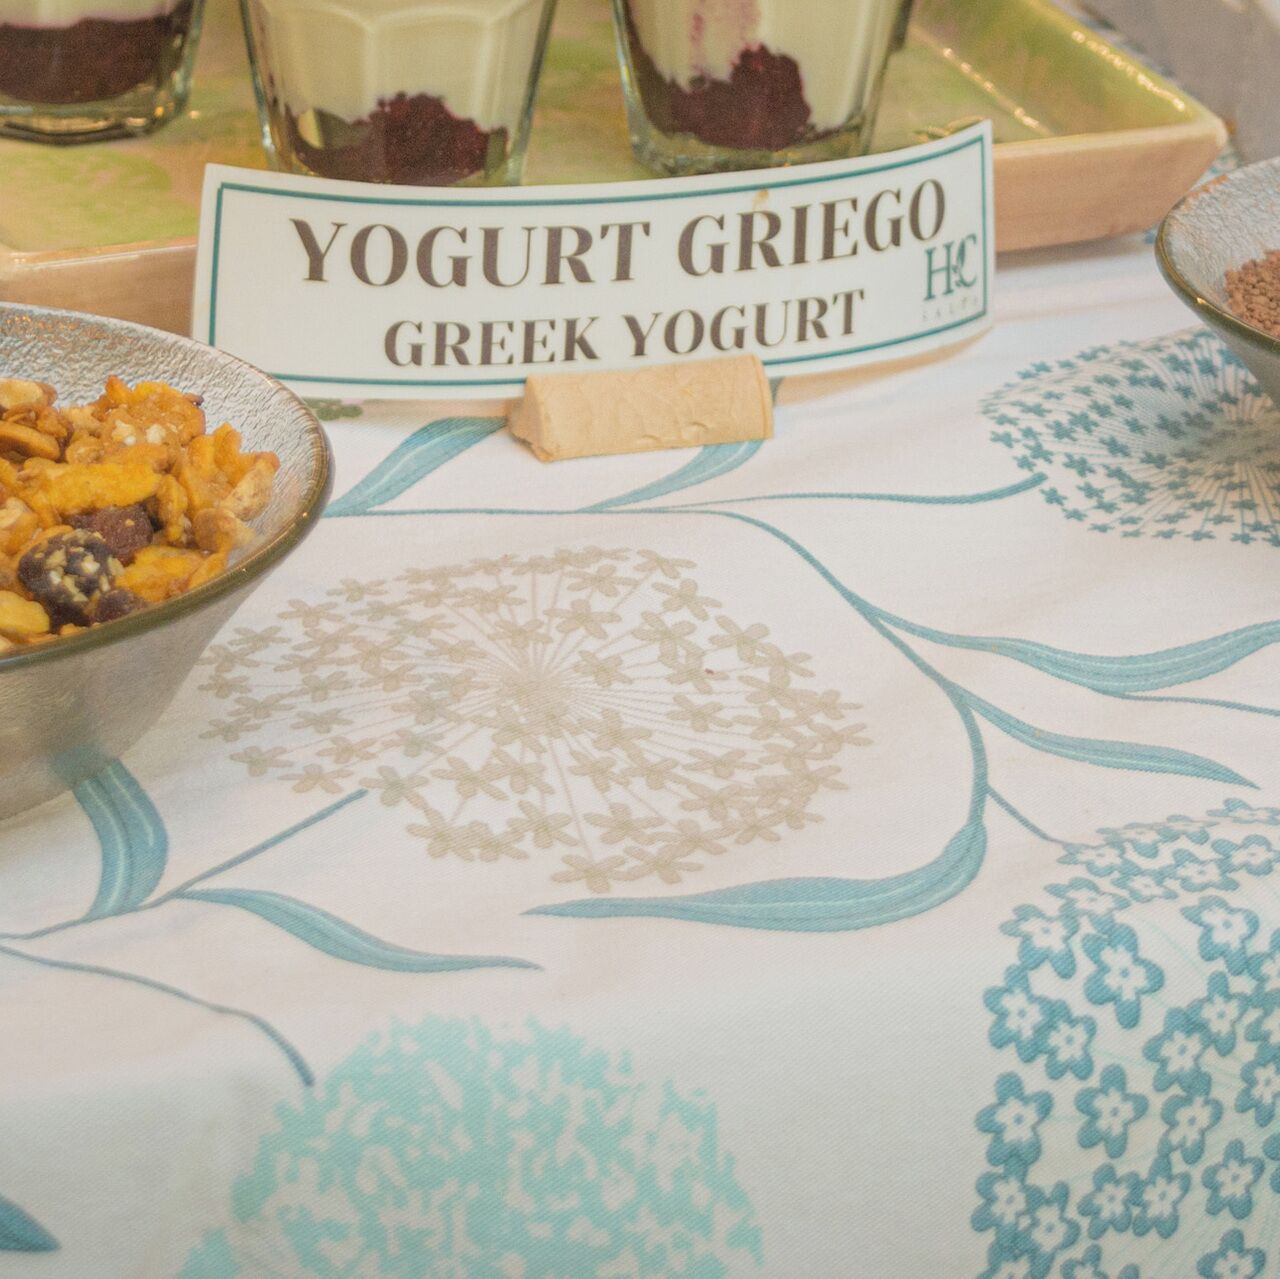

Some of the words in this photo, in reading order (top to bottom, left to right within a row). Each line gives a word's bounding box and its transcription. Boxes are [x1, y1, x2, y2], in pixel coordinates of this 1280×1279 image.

[291, 218, 651, 288] YOGURT
[677, 179, 945, 277] GRIEGO
[384, 316, 600, 368] GREEK
[622, 288, 865, 358] YOGURT
